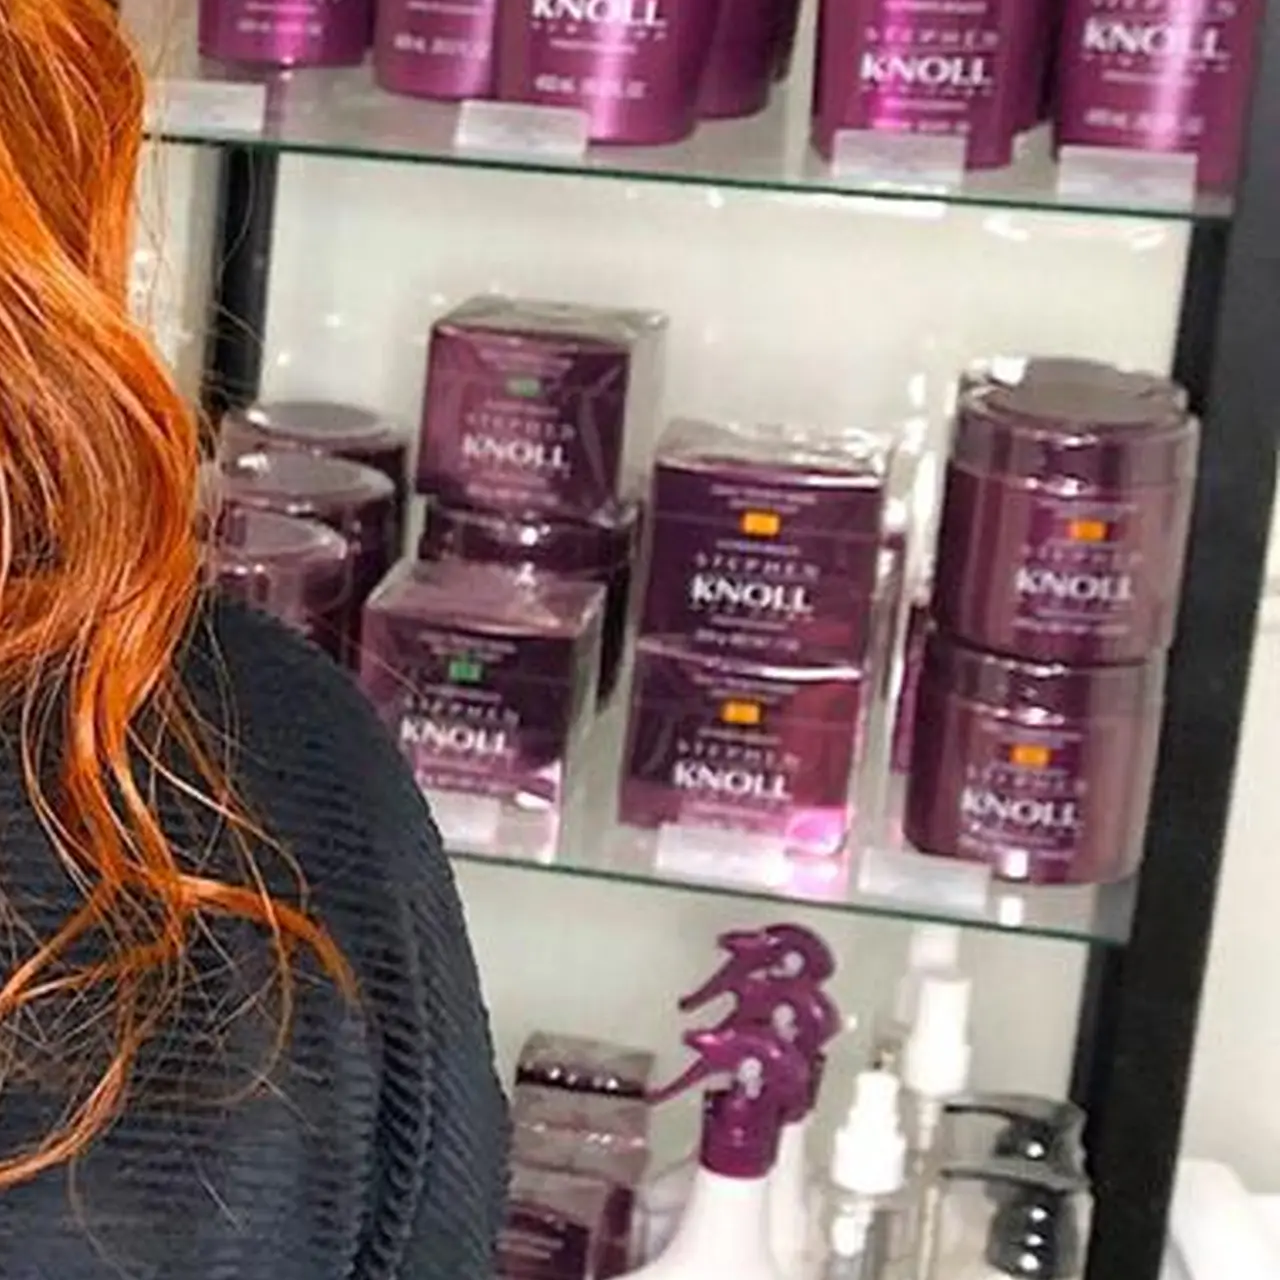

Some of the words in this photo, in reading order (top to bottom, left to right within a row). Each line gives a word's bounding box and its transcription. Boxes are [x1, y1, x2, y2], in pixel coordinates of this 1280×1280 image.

[1082, 17, 1231, 60] KNOLL
[858, 51, 993, 87] KNOLL
[461, 433, 571, 470] KNOLL
[690, 573, 815, 612] KNOLL
[1014, 567, 1136, 602] KNOLL
[400, 716, 515, 755] KNOLL
[673, 759, 794, 800] KNOLL
[959, 785, 1086, 828] KNOLL
